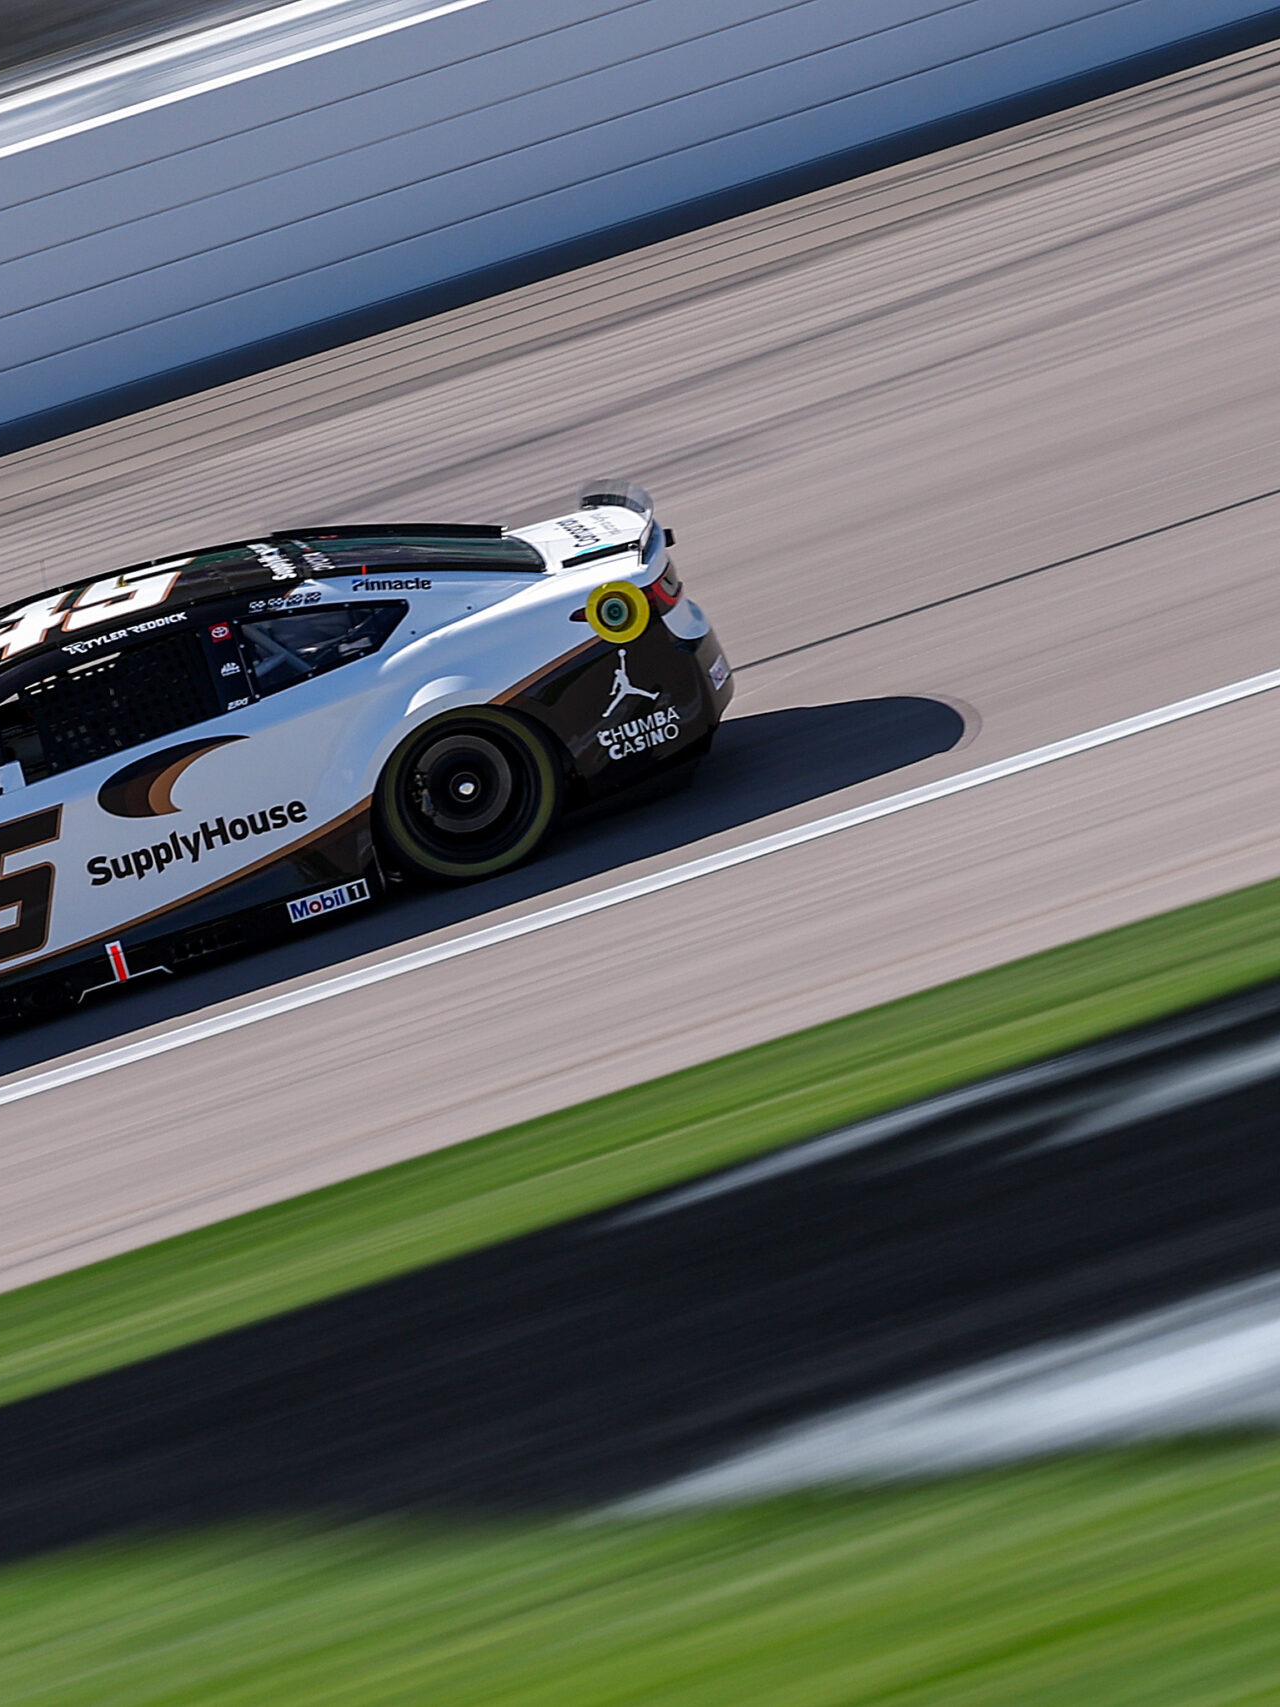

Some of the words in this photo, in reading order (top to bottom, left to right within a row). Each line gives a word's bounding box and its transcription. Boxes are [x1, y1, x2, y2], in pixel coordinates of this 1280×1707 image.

[352, 578, 431, 592] Pinnacle
[84, 629, 129, 649] TYLER
[127, 611, 188, 633] REDDICK
[597, 705, 681, 747] CHUMBA
[609, 723, 679, 760] CASINO
[86, 799, 308, 887] SupplyHouse
[291, 889, 346, 921] Mobil
[351, 885, 364, 900] 1
